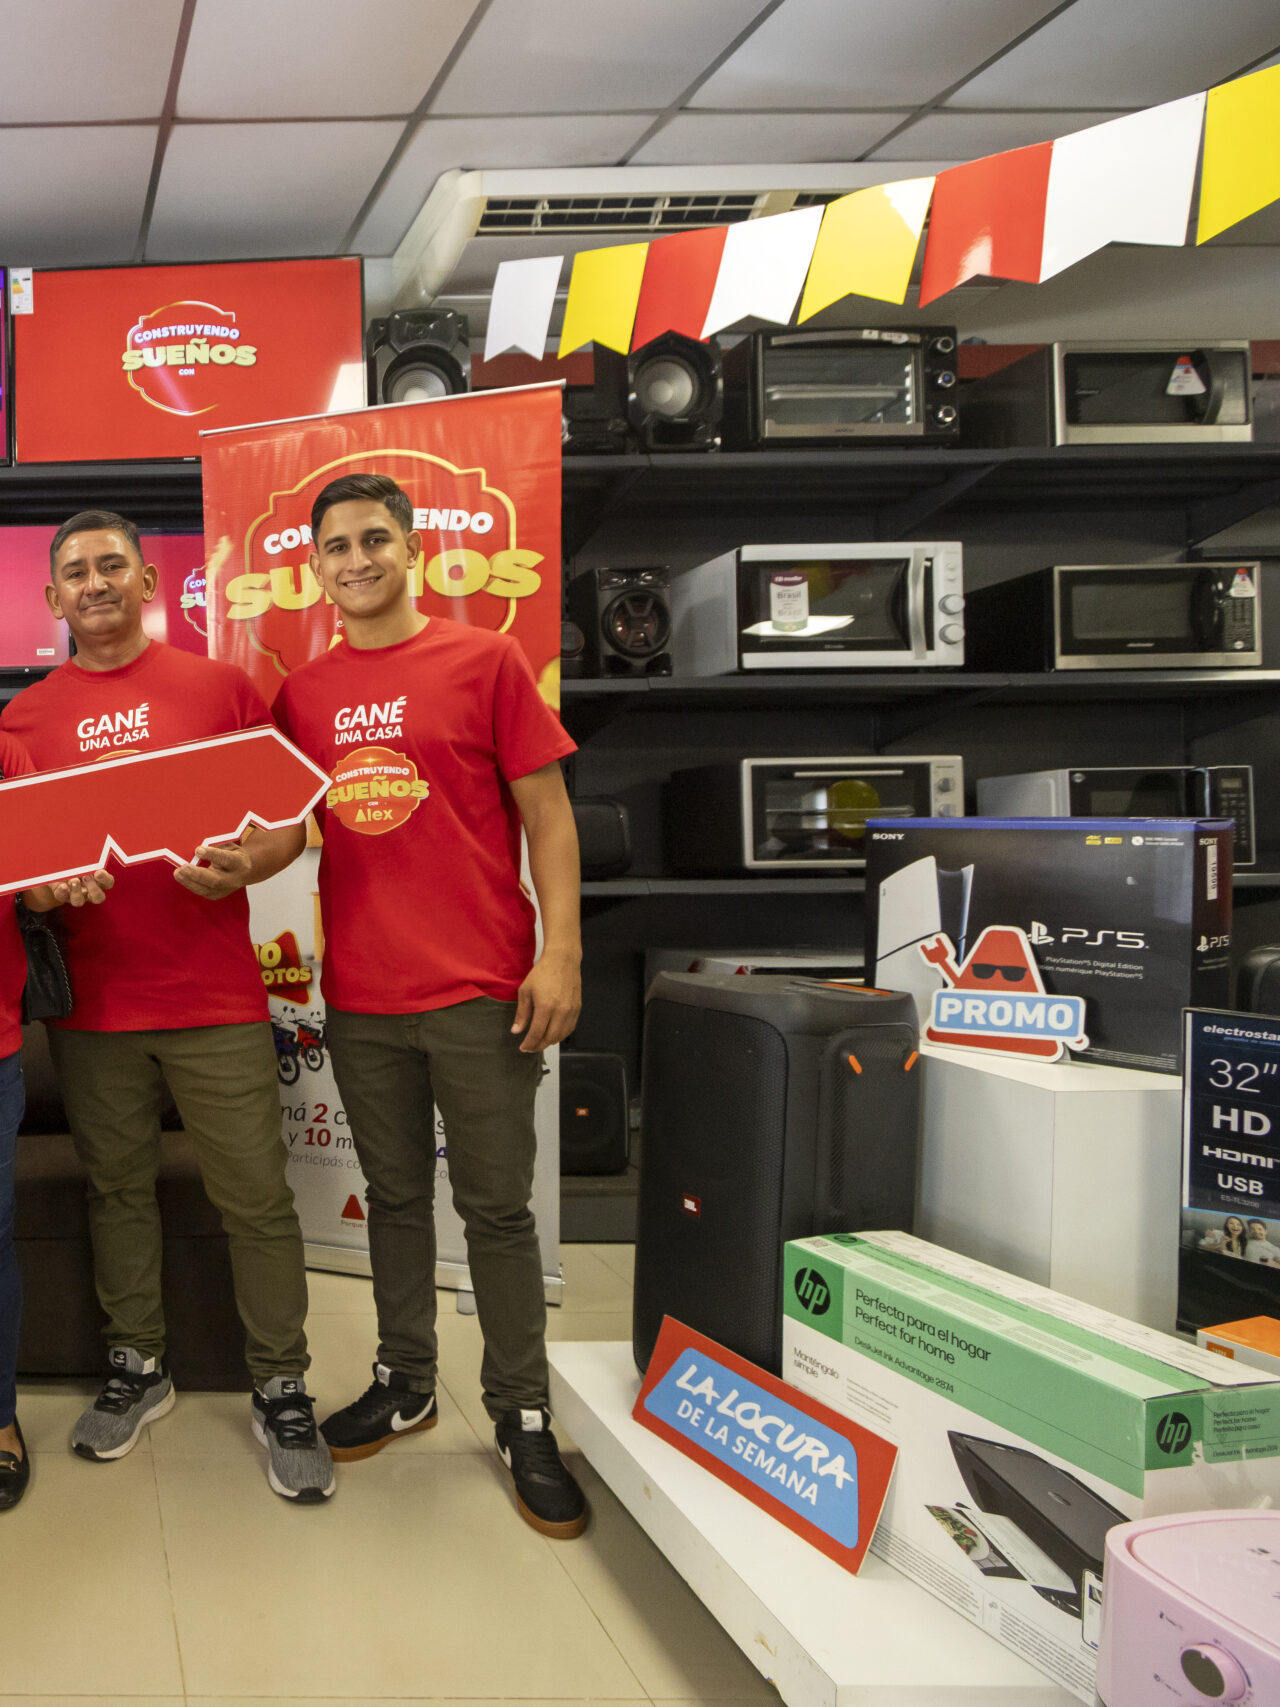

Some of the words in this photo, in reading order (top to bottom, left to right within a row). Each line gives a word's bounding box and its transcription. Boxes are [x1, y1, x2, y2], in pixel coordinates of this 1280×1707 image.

[134, 324, 240, 343] CONSTRUYENDO
[122, 338, 258, 371] SUEÑOS
[178, 368, 195, 376] CON
[225, 548, 545, 620] SUOS
[77, 702, 150, 739] GANÉ
[334, 695, 407, 731] GANÉ
[80, 736, 111, 752] UNA
[113, 727, 150, 746] CASA
[335, 729, 363, 745] UNA
[365, 725, 403, 741] CASA
[335, 766, 410, 783] CONSTRUYENDO
[326, 775, 430, 808] SUEÑOS
[355, 808, 394, 823] Alex
[1062, 927, 1145, 949] PS5
[261, 966, 312, 985] OTOS
[1093, 961, 1116, 969] Digital
[1117, 963, 1144, 971] Edition
[939, 997, 1074, 1031] PROMO
[1203, 1025, 1280, 1042] electrosta
[312, 1103, 328, 1124] 2
[1212, 1105, 1272, 1136] HD
[288, 1131, 298, 1147] y
[304, 1127, 331, 1147] 10
[1217, 1173, 1264, 1196] USB
[796, 1267, 830, 1316] hp
[855, 1306, 897, 1338] Perfect
[899, 1328, 916, 1345] for
[918, 1335, 956, 1365] home
[856, 1288, 905, 1322] Perfecta
[907, 1315, 936, 1337] para
[938, 1329, 949, 1343] el
[951, 1332, 991, 1362] hogar
[794, 1347, 839, 1379] Manténgalo
[794, 1359, 819, 1379] simple
[855, 1336, 883, 1360] DeskJet
[884, 1350, 894, 1363] Ink
[894, 1357, 934, 1384] Advantage
[935, 1377, 954, 1393] 2874
[676, 1364, 720, 1405] LA
[716, 1389, 855, 1488] LOCURA
[1157, 1410, 1191, 1455] hp
[677, 1399, 704, 1427] DE
[704, 1415, 729, 1445] LA
[732, 1436, 818, 1506] SEMANA
